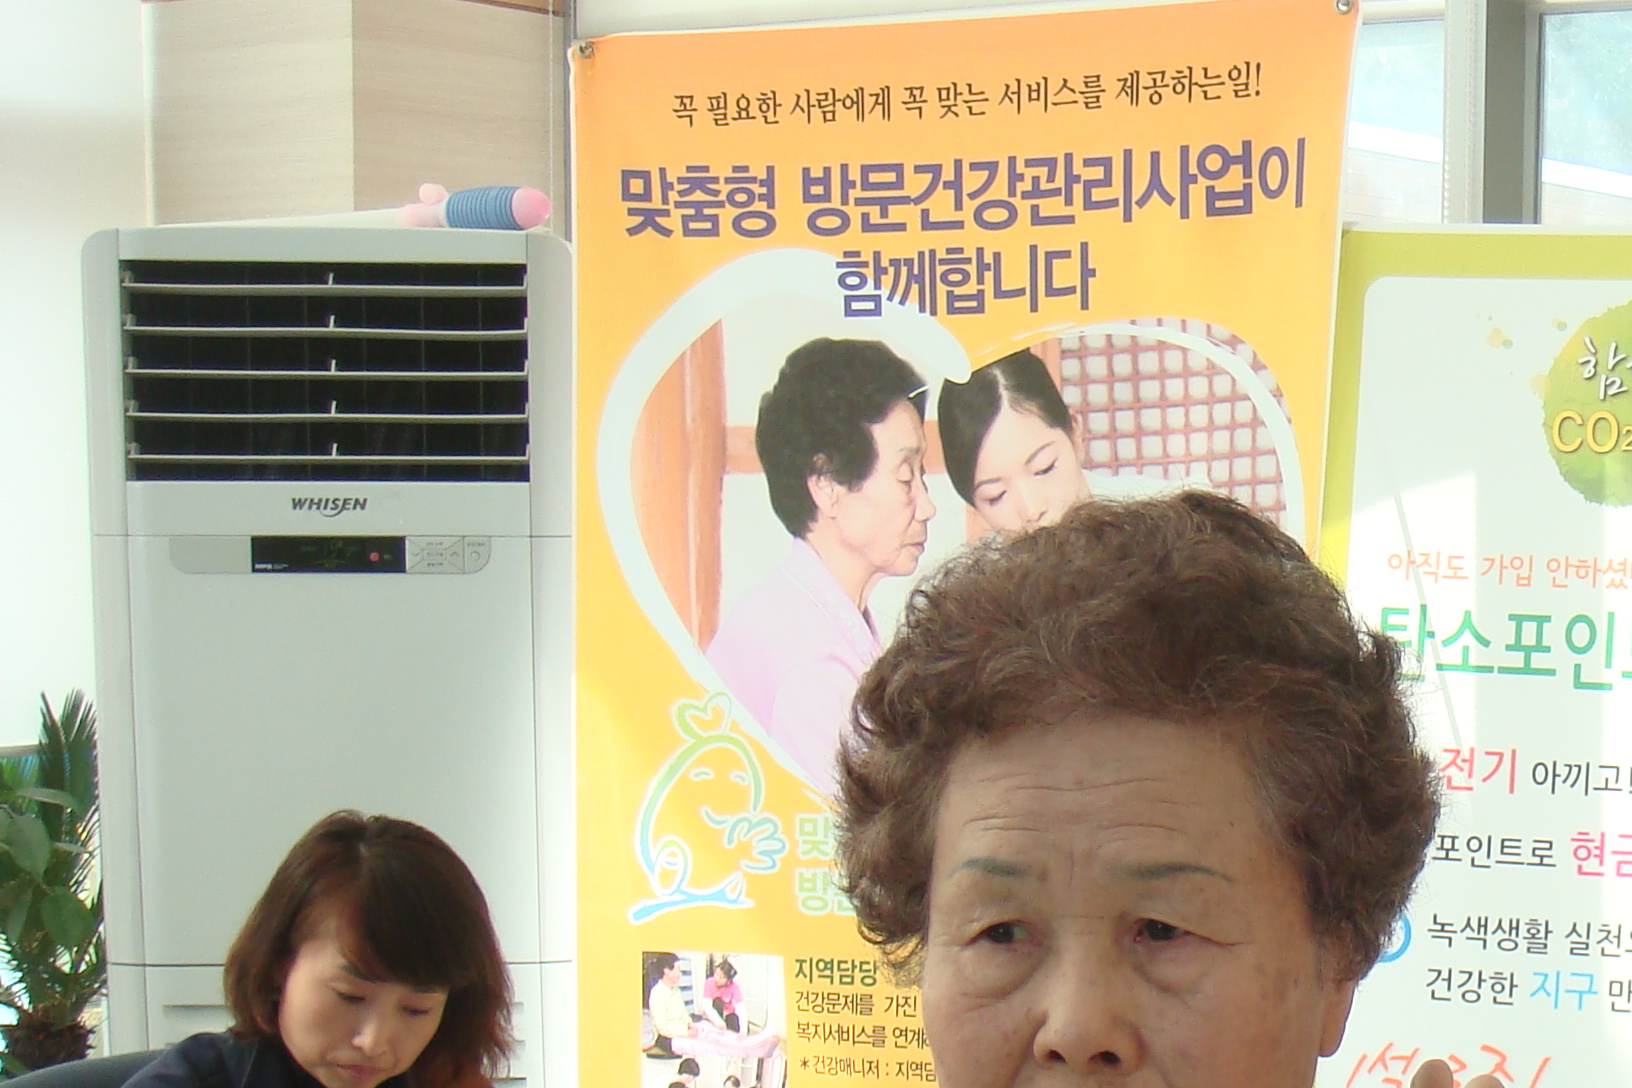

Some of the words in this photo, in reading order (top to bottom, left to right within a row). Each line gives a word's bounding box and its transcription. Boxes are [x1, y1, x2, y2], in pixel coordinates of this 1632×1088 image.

[672, 94, 698, 128] 꼭
[706, 90, 782, 127] 필요한
[790, 86, 892, 125] 사람에게
[901, 85, 928, 119] 꼭
[936, 81, 990, 119] 맞는
[998, 74, 1106, 115] 서비스를
[1115, 61, 1262, 108] 제공하는일!
[620, 164, 777, 239] 맞춤형
[801, 137, 1306, 237] 방문건강관리사업이
[835, 241, 1097, 318] 함께합니다
[291, 497, 368, 516] WHISEN
[1388, 549, 1469, 583] 아직도
[1480, 553, 1534, 588] 가입
[1439, 746, 1517, 794] 전기
[1431, 833, 1557, 869] 포인트로
[1426, 912, 1554, 955] 녹색생활
[794, 956, 879, 988] 지역담당
[1425, 966, 1519, 1007] 건강한
[1529, 969, 1598, 1012] 지구
[795, 990, 875, 1016] 건강문제를
[884, 993, 918, 1018] 가진
[796, 1020, 888, 1049] 복지서비스를
[892, 1025, 930, 1050] 연계
[812, 1054, 880, 1080] 건강매니저
